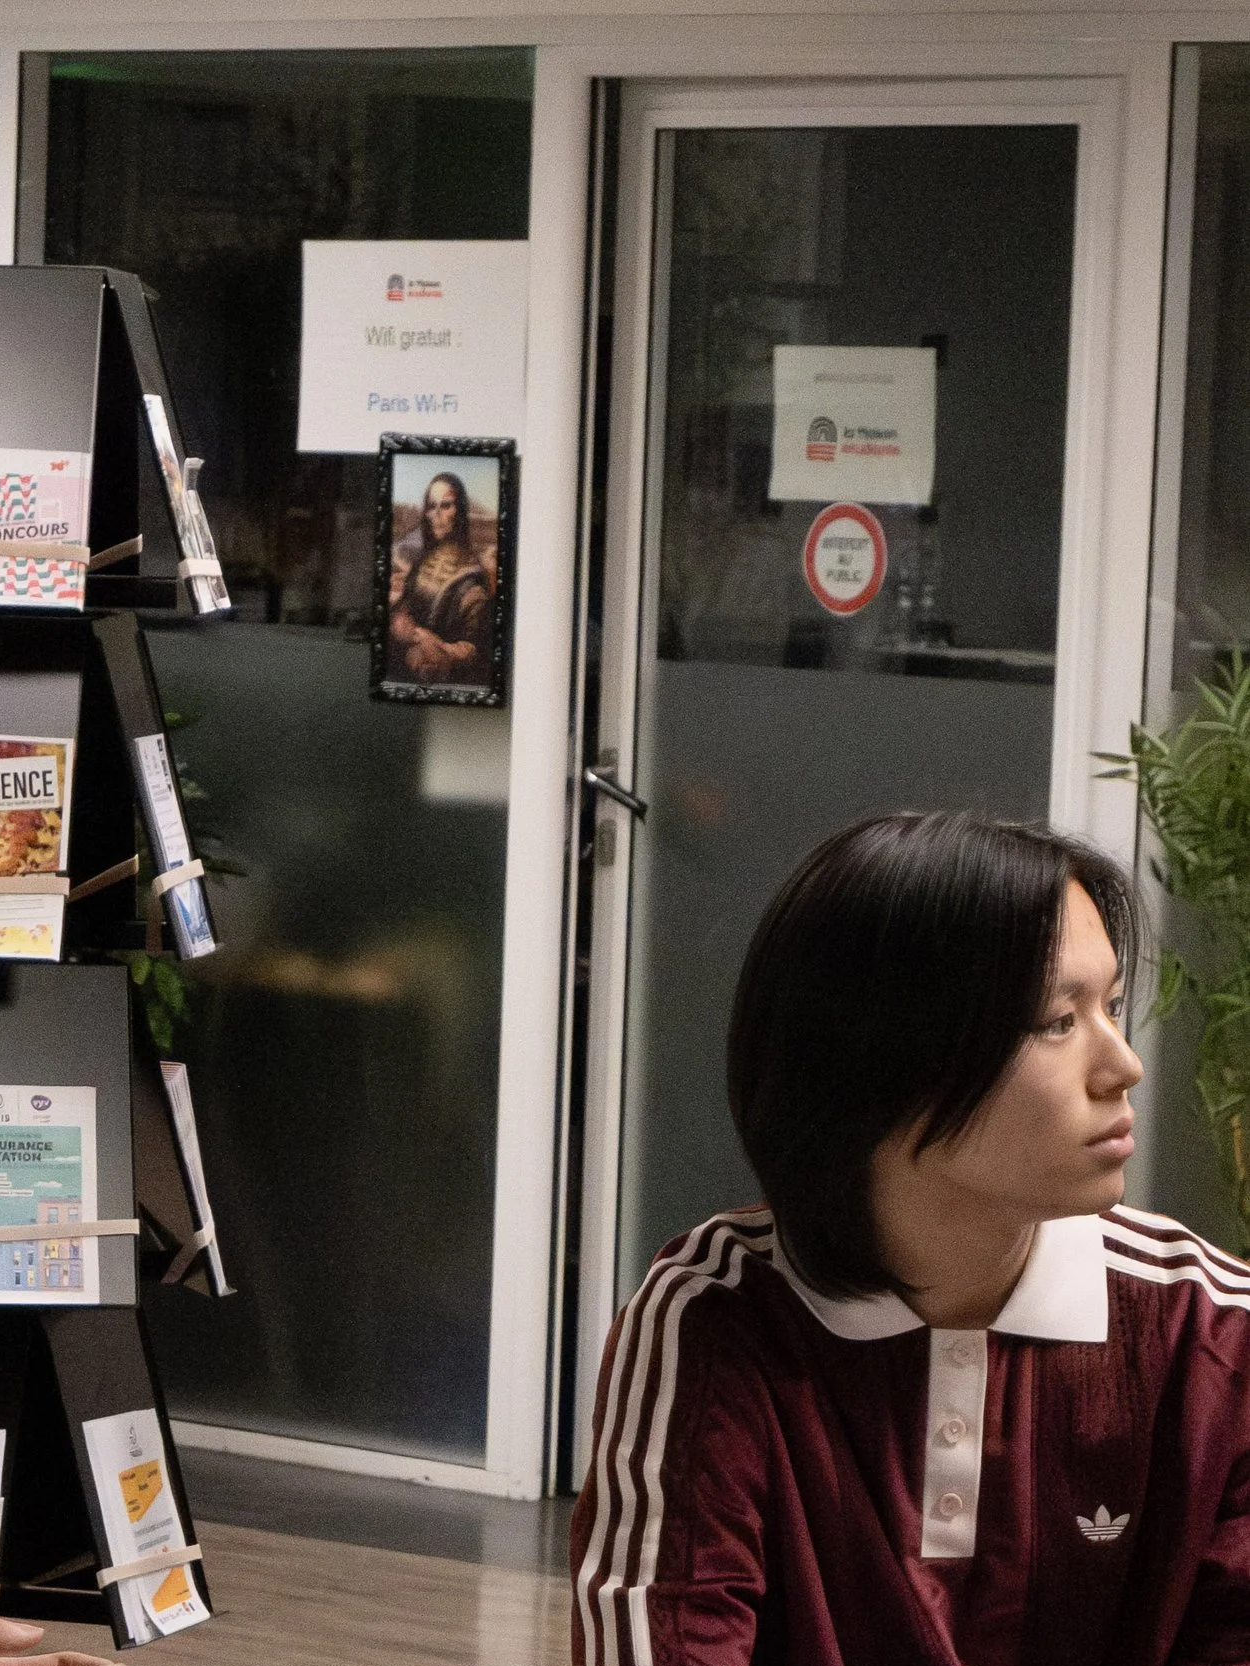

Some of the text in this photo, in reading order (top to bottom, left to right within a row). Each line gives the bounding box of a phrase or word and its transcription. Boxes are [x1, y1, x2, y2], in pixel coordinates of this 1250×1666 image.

[399, 329, 451, 351] gratuit
[367, 392, 459, 412] Paris Wi-Fi
